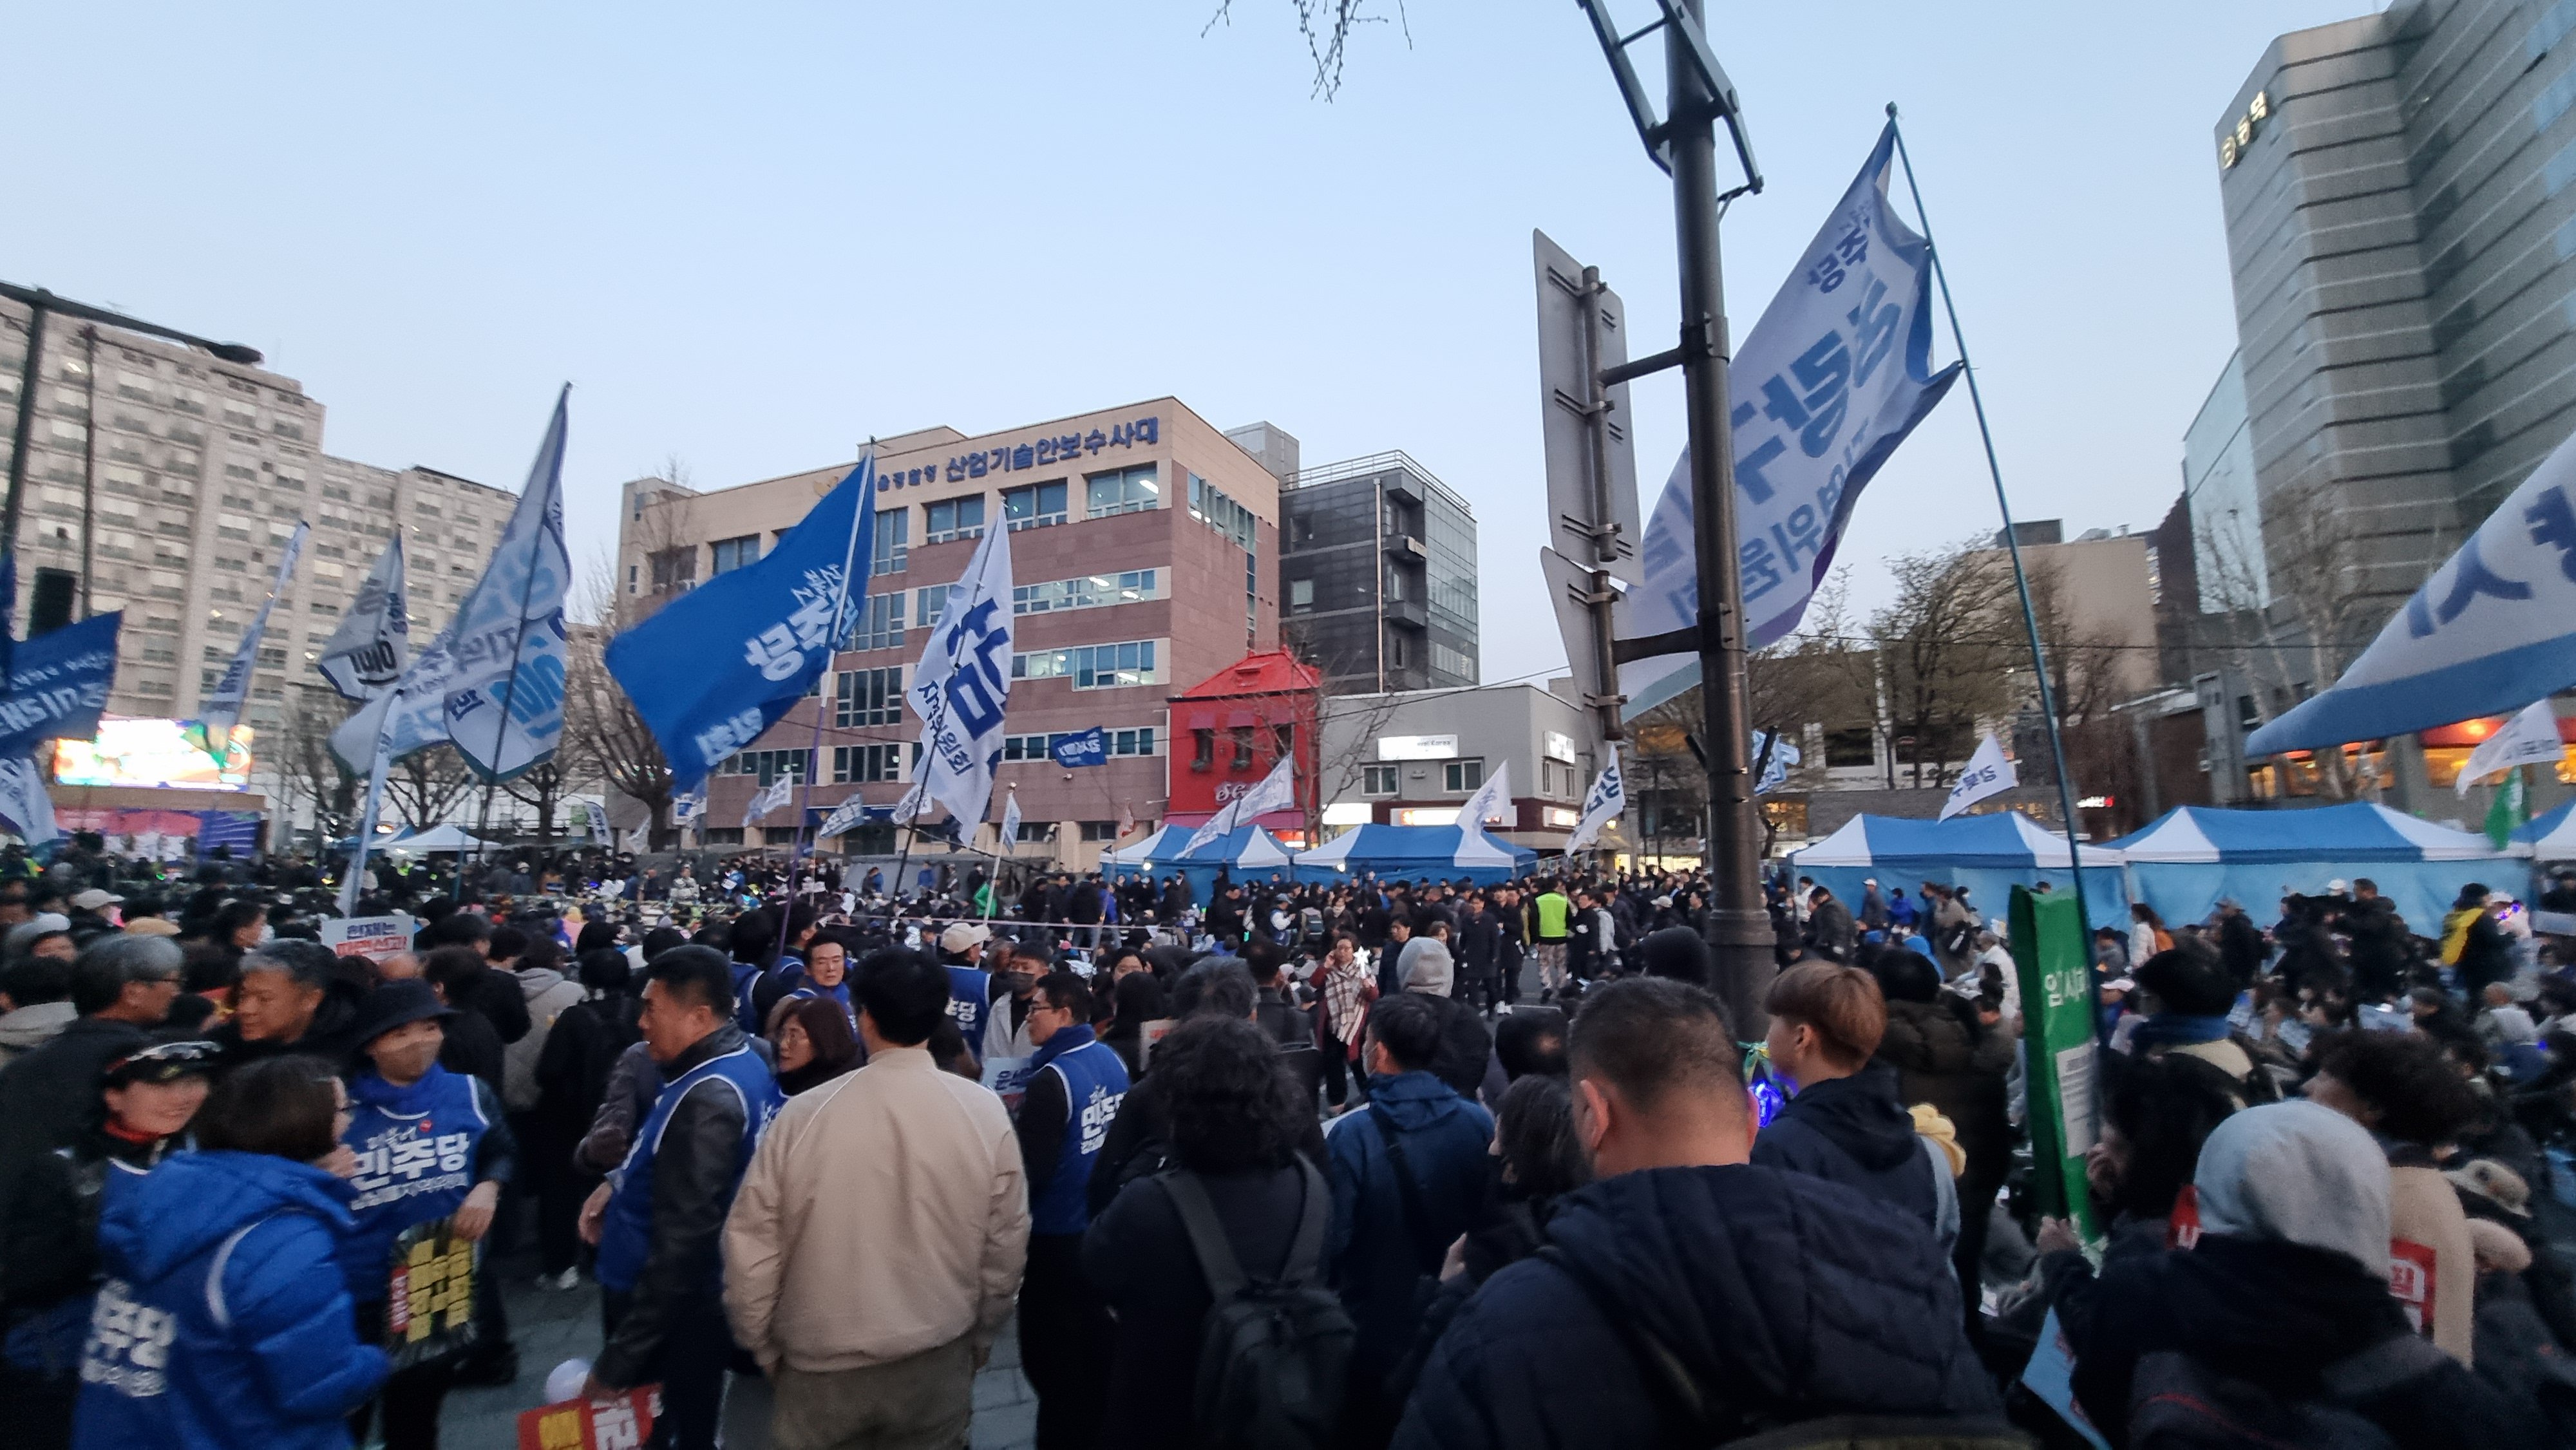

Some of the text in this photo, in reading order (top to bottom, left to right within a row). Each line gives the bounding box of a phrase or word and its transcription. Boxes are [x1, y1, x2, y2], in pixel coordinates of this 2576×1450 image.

[877, 417, 1158, 492] 울경찰청 산업기술안보수사대
[351, 1133, 470, 1191] 민주당
